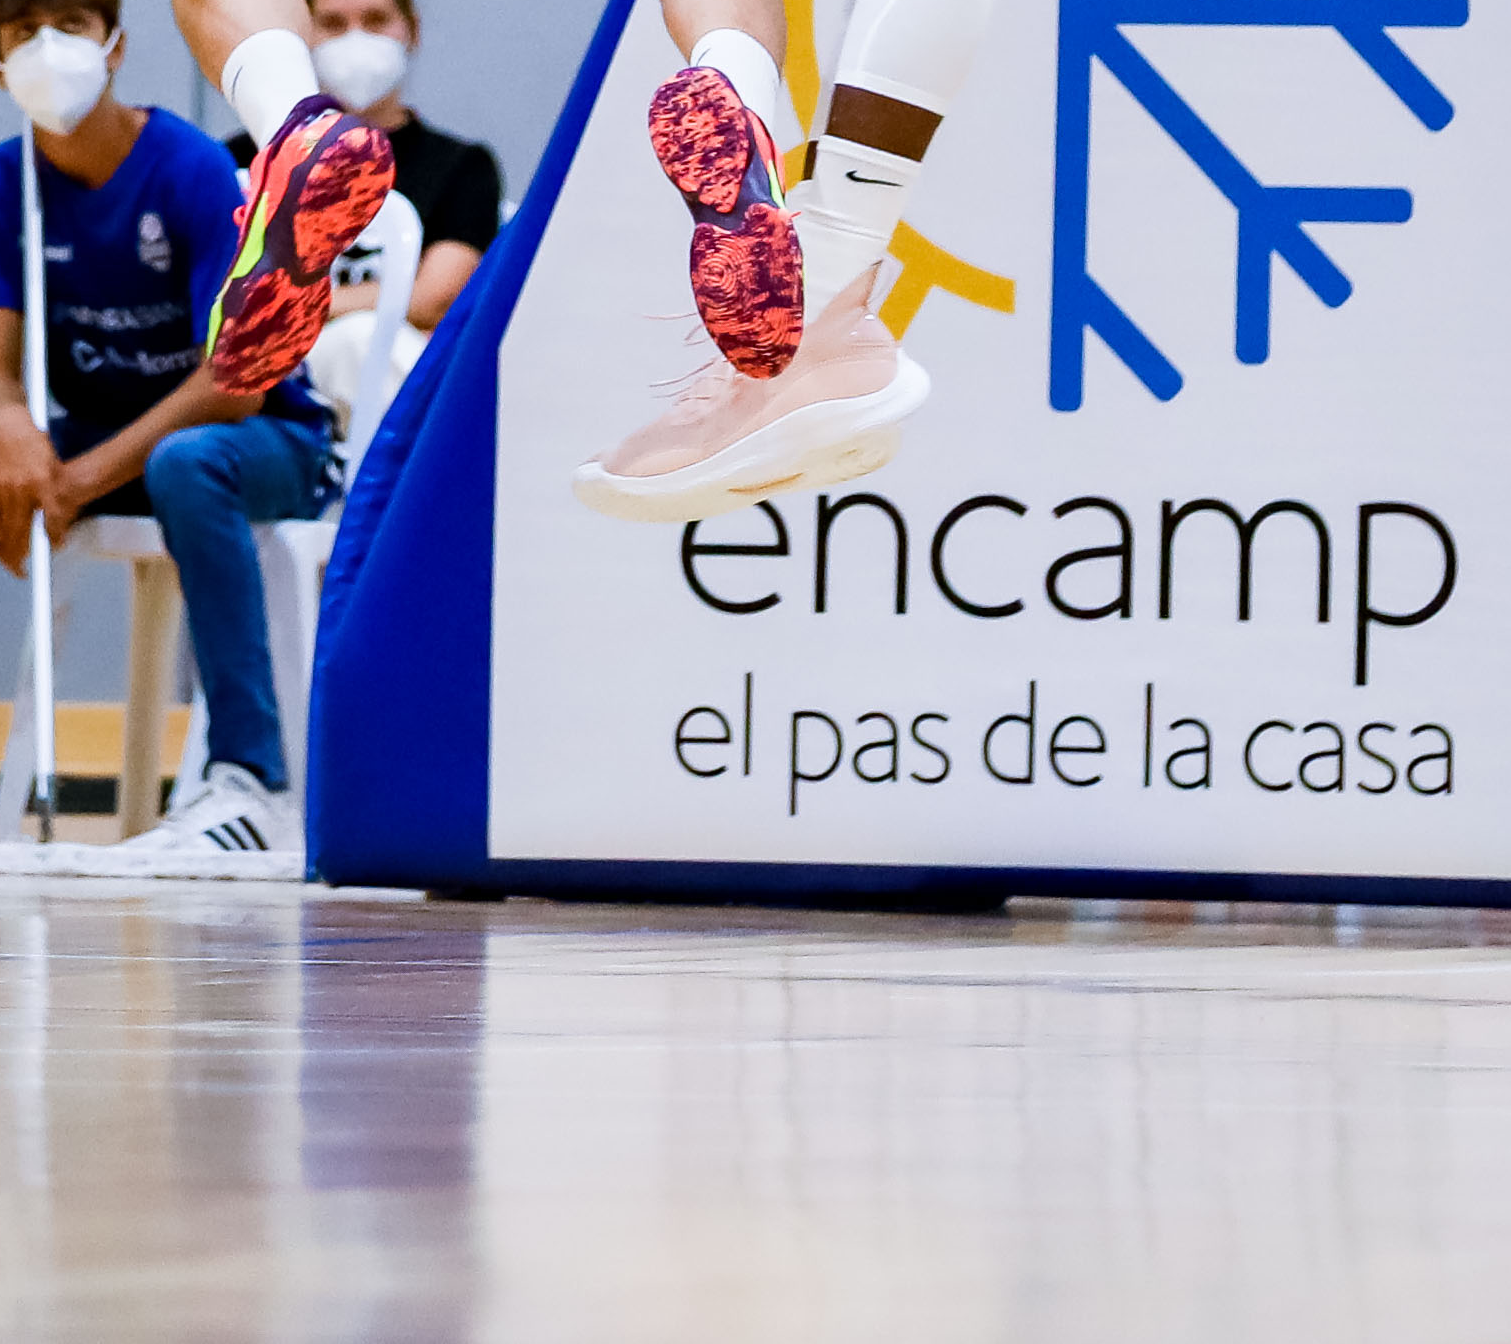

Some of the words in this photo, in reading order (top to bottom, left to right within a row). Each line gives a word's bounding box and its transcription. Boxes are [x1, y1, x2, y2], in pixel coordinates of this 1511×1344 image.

[680, 490, 1460, 687] encamp
[674, 672, 753, 777] el
[788, 709, 952, 817] pas
[982, 679, 1108, 788] de
[1143, 682, 1212, 790] la
[1243, 718, 1457, 796] casa
